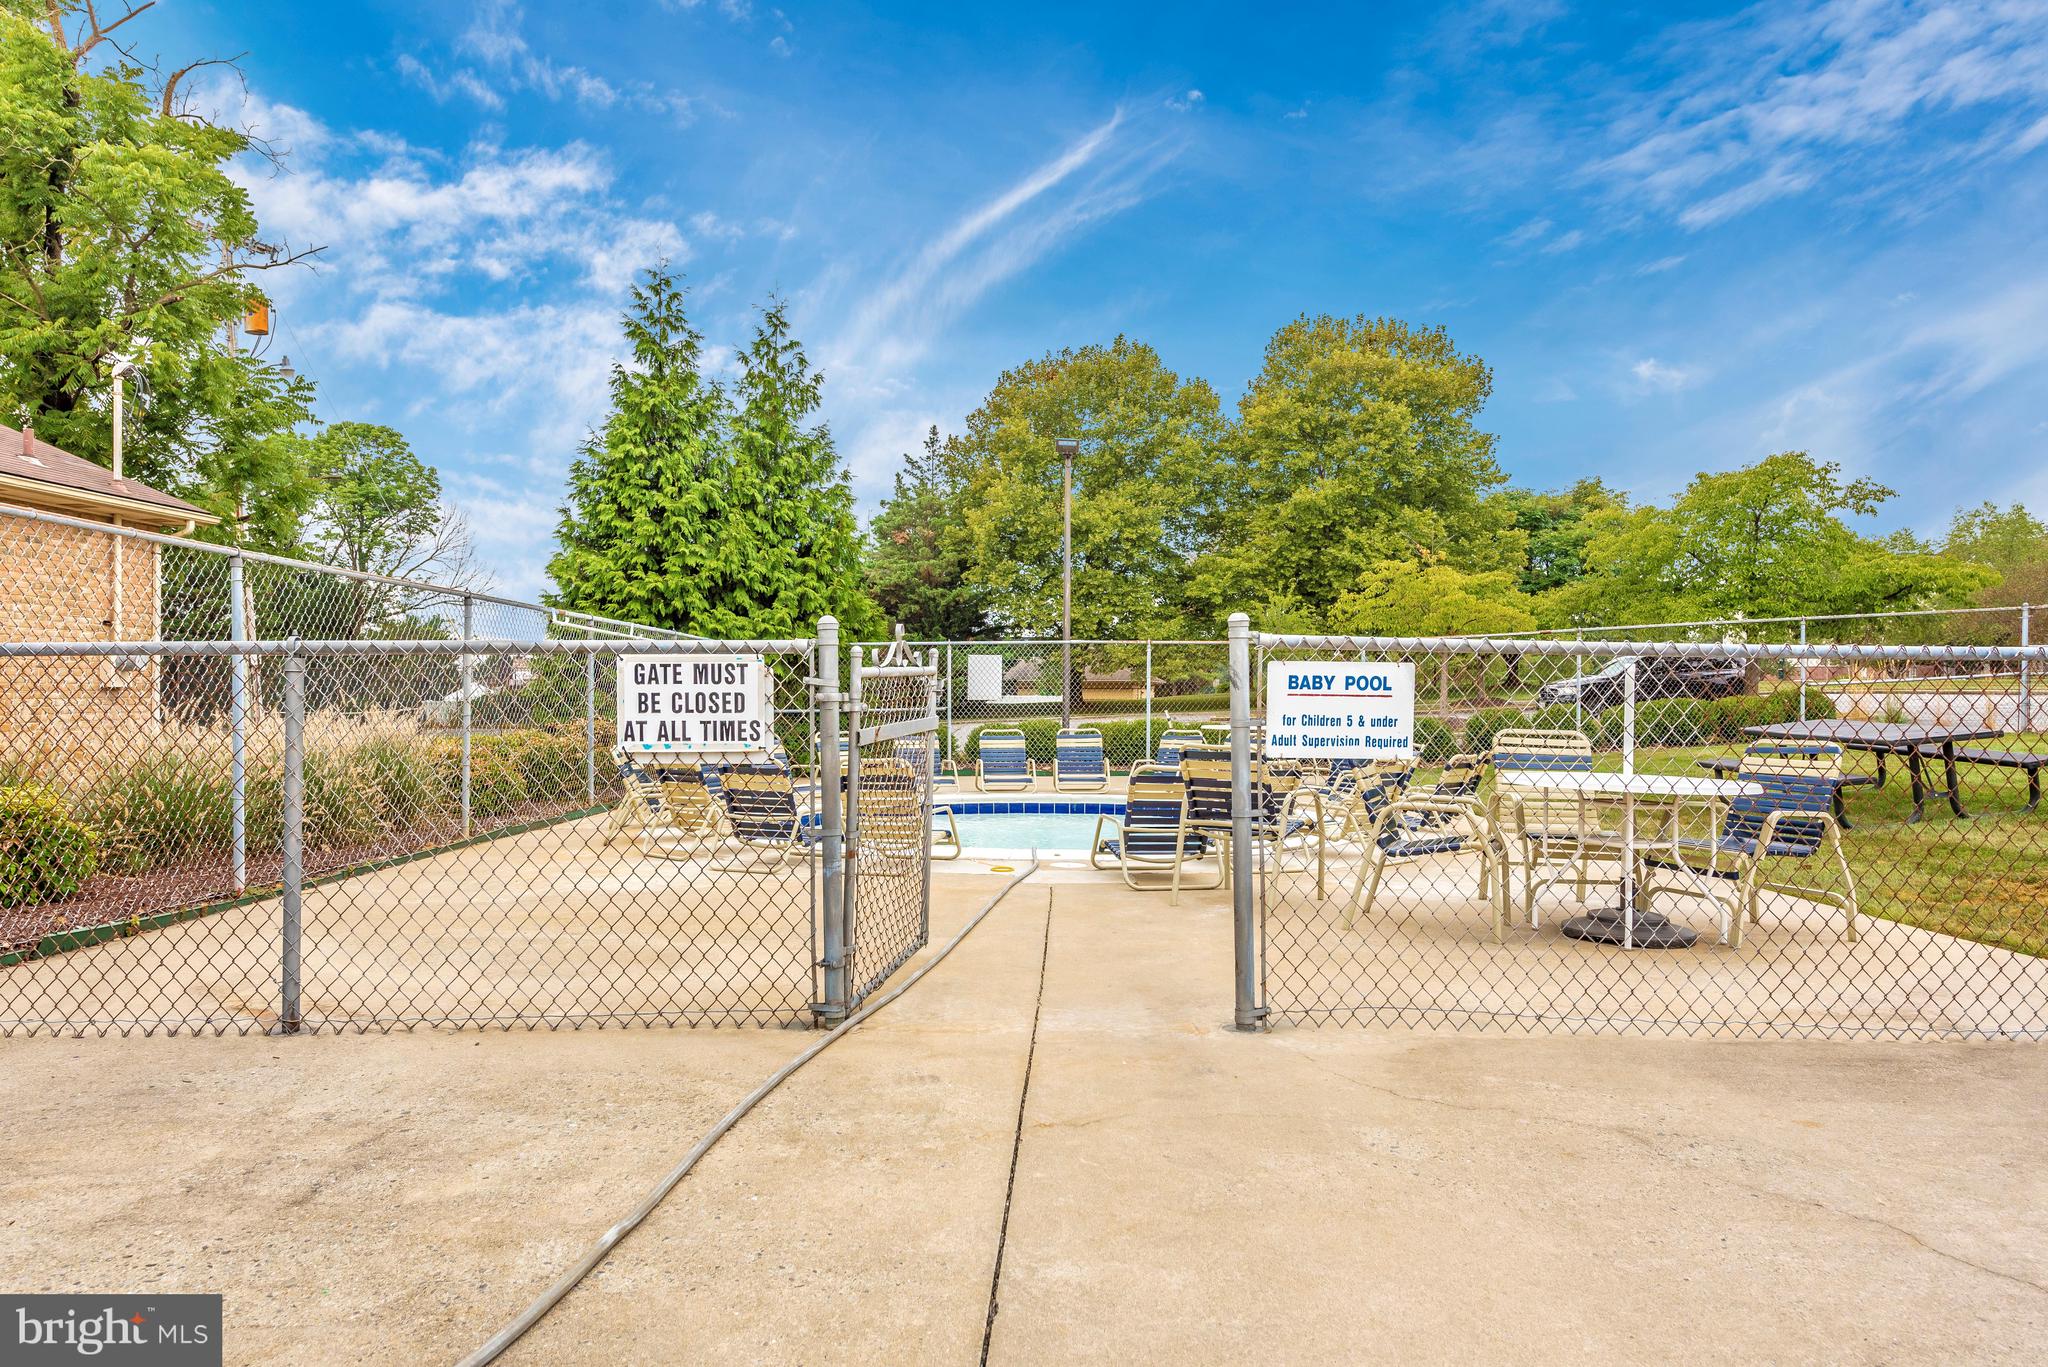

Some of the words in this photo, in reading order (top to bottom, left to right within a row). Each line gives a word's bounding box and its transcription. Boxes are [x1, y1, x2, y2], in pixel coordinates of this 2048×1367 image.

[634, 663, 683, 685] GATE
[693, 663, 749, 685] MUST
[1288, 674, 1336, 690] BABY
[1345, 675, 1392, 691] POOL
[637, 692, 661, 714] BE
[671, 692, 746, 714] CLOSED
[1282, 714, 1297, 726] for
[1301, 714, 1342, 727] Children
[1346, 714, 1353, 727] 5
[1358, 716, 1365, 727] &
[1370, 715, 1398, 728] under
[623, 720, 648, 742] AT
[657, 720, 692, 742] ALL
[699, 720, 761, 742] TIMES
[1271, 734, 1297, 747] Adult
[1302, 734, 1360, 749] Supervision
[1365, 735, 1409, 749] Required
